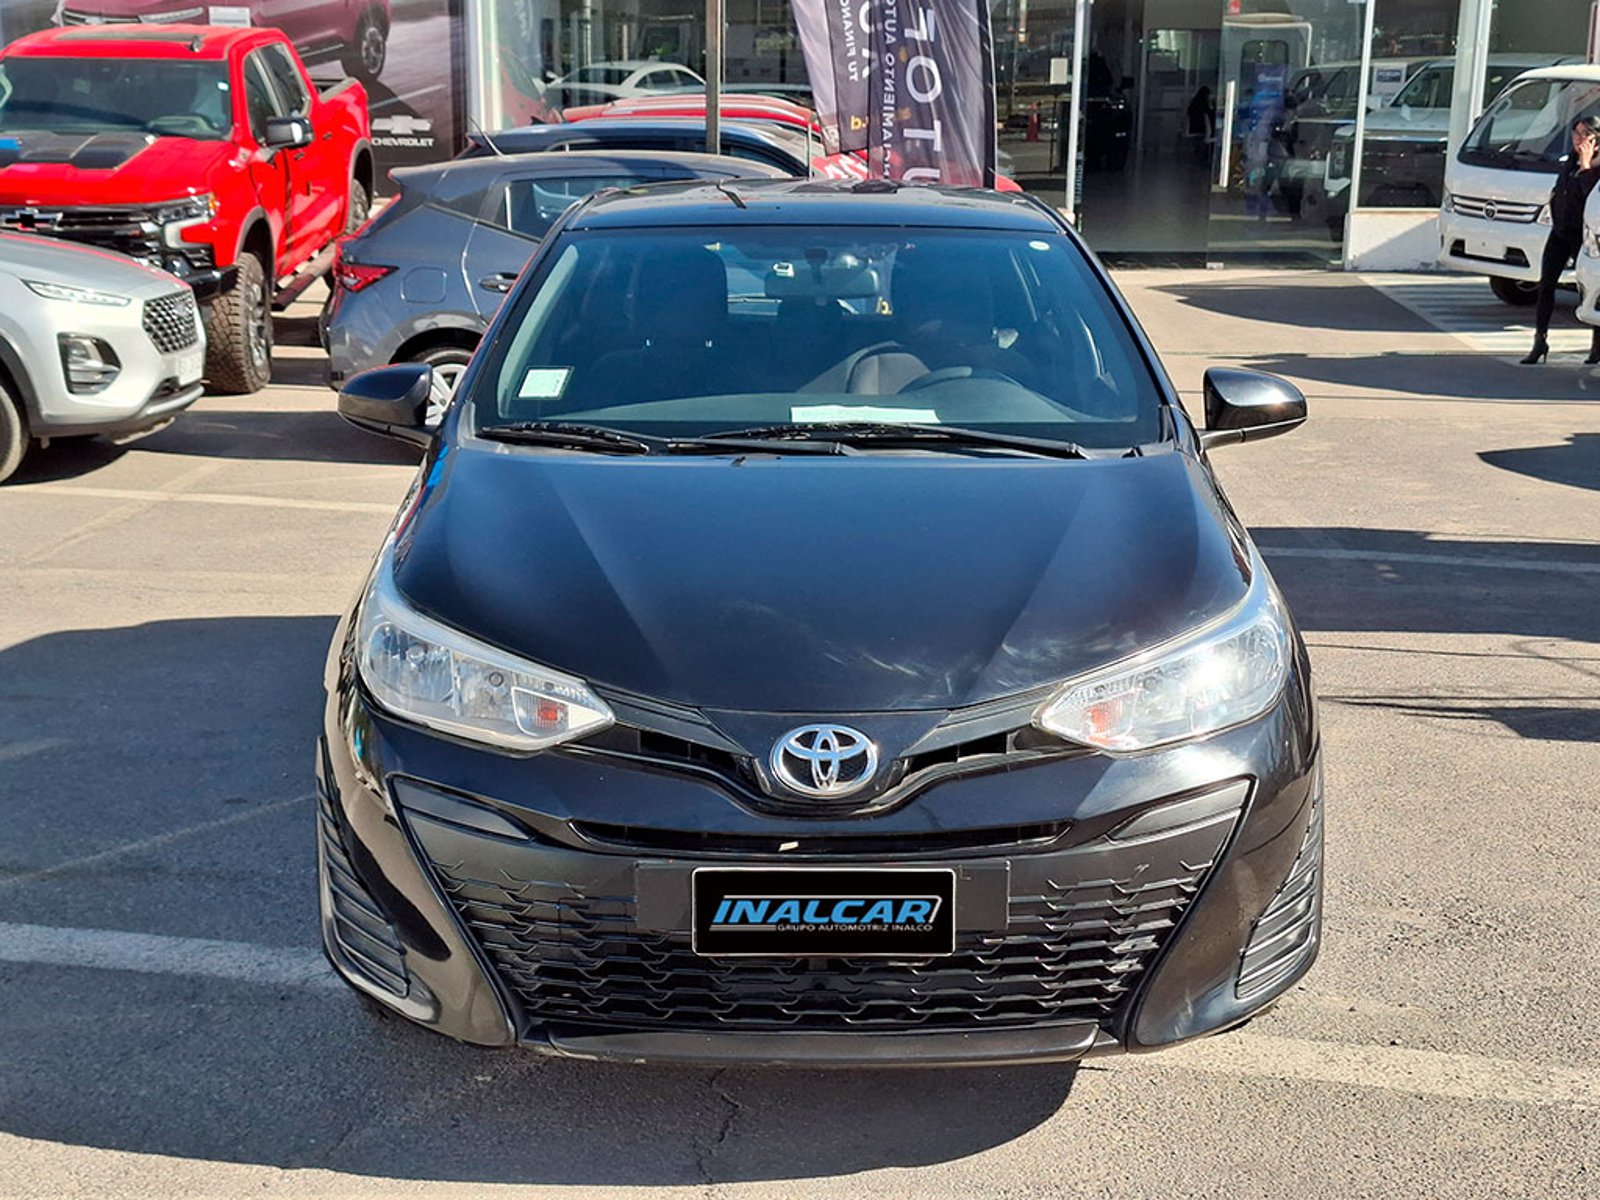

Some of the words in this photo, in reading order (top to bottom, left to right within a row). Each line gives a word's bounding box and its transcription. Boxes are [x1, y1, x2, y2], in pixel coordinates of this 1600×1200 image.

[371, 137, 435, 147] CHEVROLET
[712, 899, 933, 924] INALCAR
[777, 924, 816, 932] GRUPO
[818, 924, 889, 932] AUTOMOTRIZ
[891, 924, 933, 932] INALCO
